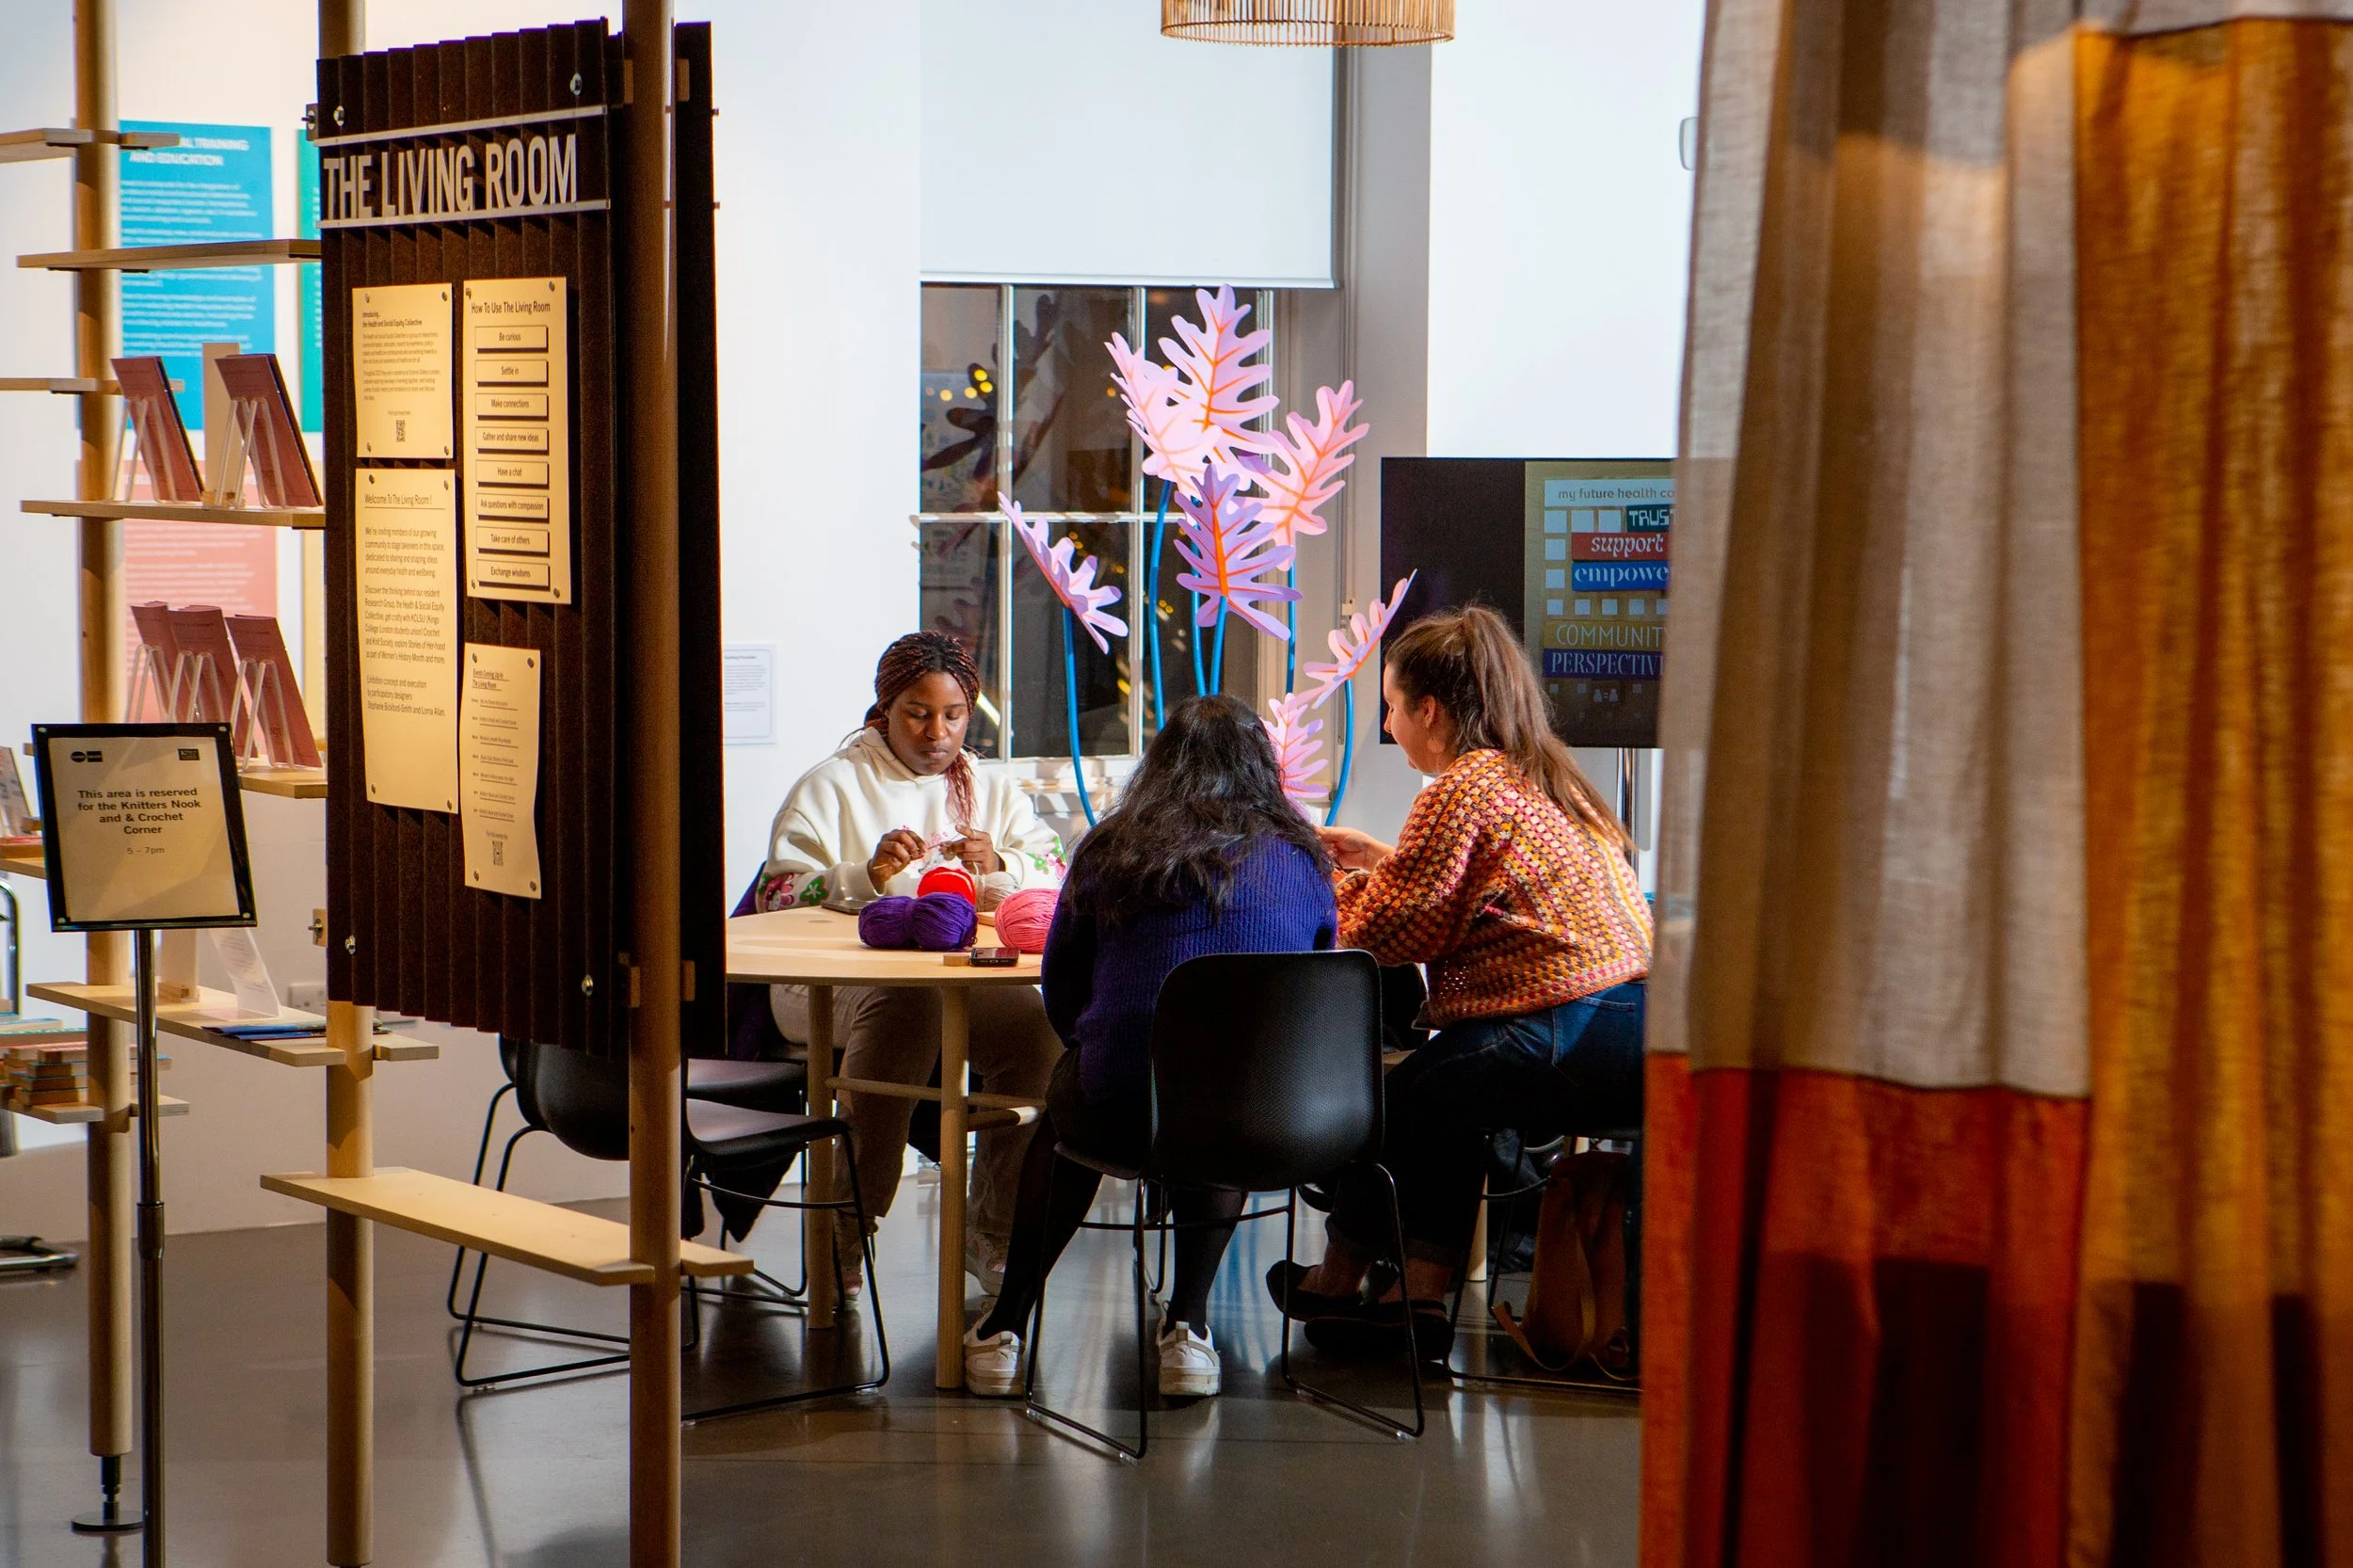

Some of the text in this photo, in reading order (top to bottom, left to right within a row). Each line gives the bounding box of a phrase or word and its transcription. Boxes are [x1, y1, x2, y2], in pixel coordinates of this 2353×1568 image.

[324, 154, 373, 219] THE
[381, 145, 474, 216] LIVING
[486, 134, 577, 211] ROOM
[471, 300, 550, 315] How To Use The Living Room
[499, 331, 521, 341] Be curious
[501, 366, 514, 375] Settle
[491, 399, 529, 408] Make connections
[483, 432, 496, 440] Gather
[505, 432, 517, 441] share
[527, 433, 539, 442] ideas
[498, 467, 508, 476] Have
[513, 467, 522, 476] chat
[364, 493, 387, 504] Welcome
[387, 494, 392, 504] To
[401, 494, 414, 506] Living
[415, 495, 429, 504] Room
[1558, 488, 1576, 502] my
[1579, 488, 1614, 499] future
[1617, 487, 1657, 498] health
[488, 499, 507, 509] questions
[508, 500, 517, 509] with
[518, 502, 544, 511] compassion
[491, 534, 531, 544] Take care of others
[1591, 534, 1664, 558] support
[491, 567, 531, 578] Exchange wisdoms
[1575, 567, 1670, 588] empowe
[1557, 624, 1666, 648] COMMUNIT
[77, 787, 198, 799] This area is reserved
[77, 799, 200, 811] for the Knitters Nook
[99, 812, 184, 824] and & Crochet
[123, 825, 162, 835] Corner
[145, 846, 165, 855] 7pm
